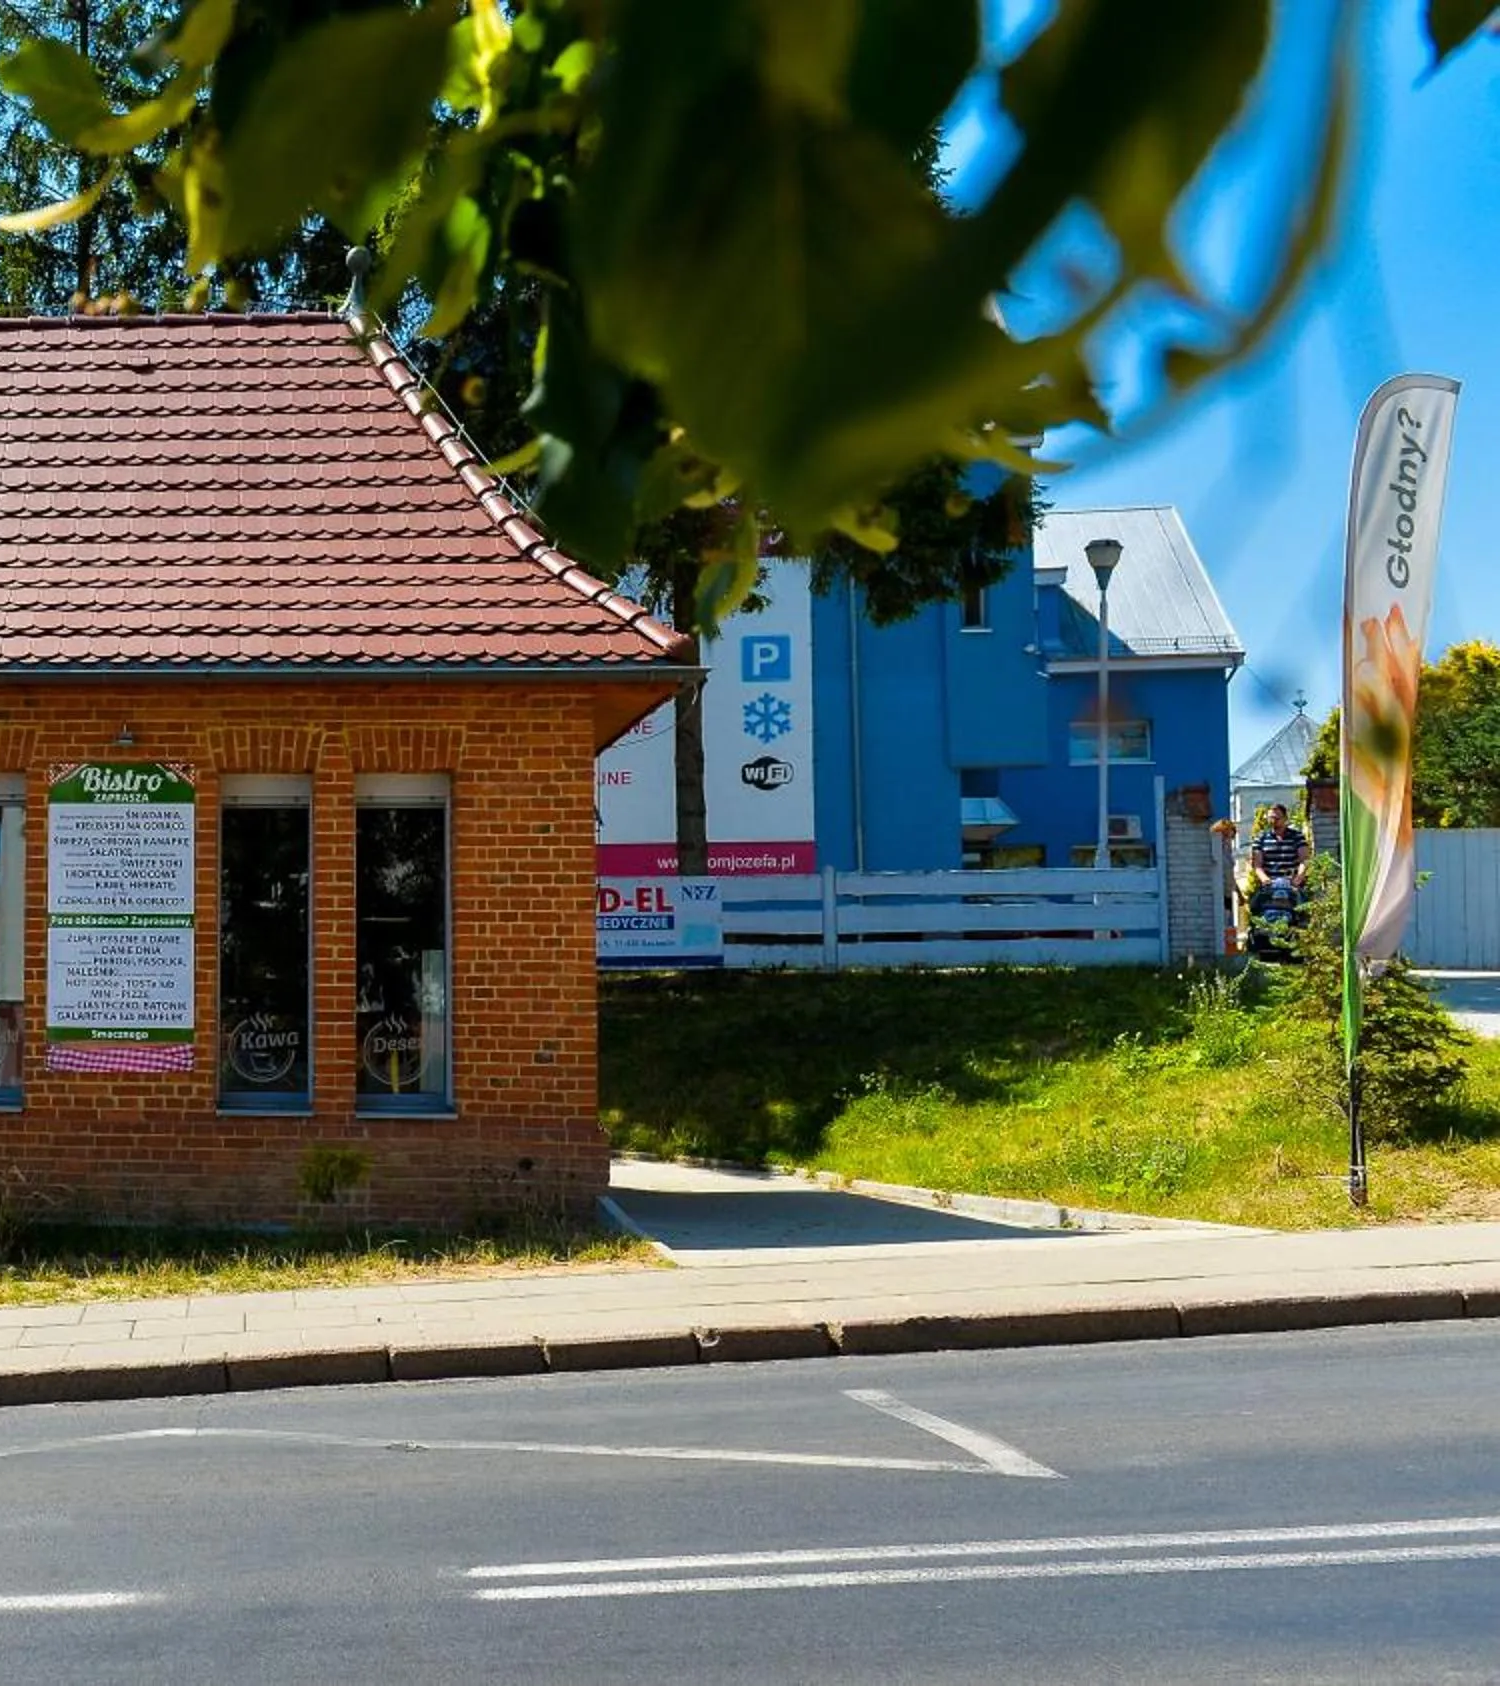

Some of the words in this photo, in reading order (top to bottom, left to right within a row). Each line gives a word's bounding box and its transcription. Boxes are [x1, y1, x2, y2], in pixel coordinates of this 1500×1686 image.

[81, 767, 163, 791] Bistro
[94, 793, 149, 804] ZAPRASZA
[91, 1029, 150, 1041] Smacznego
[240, 1031, 300, 1051] Kawa
